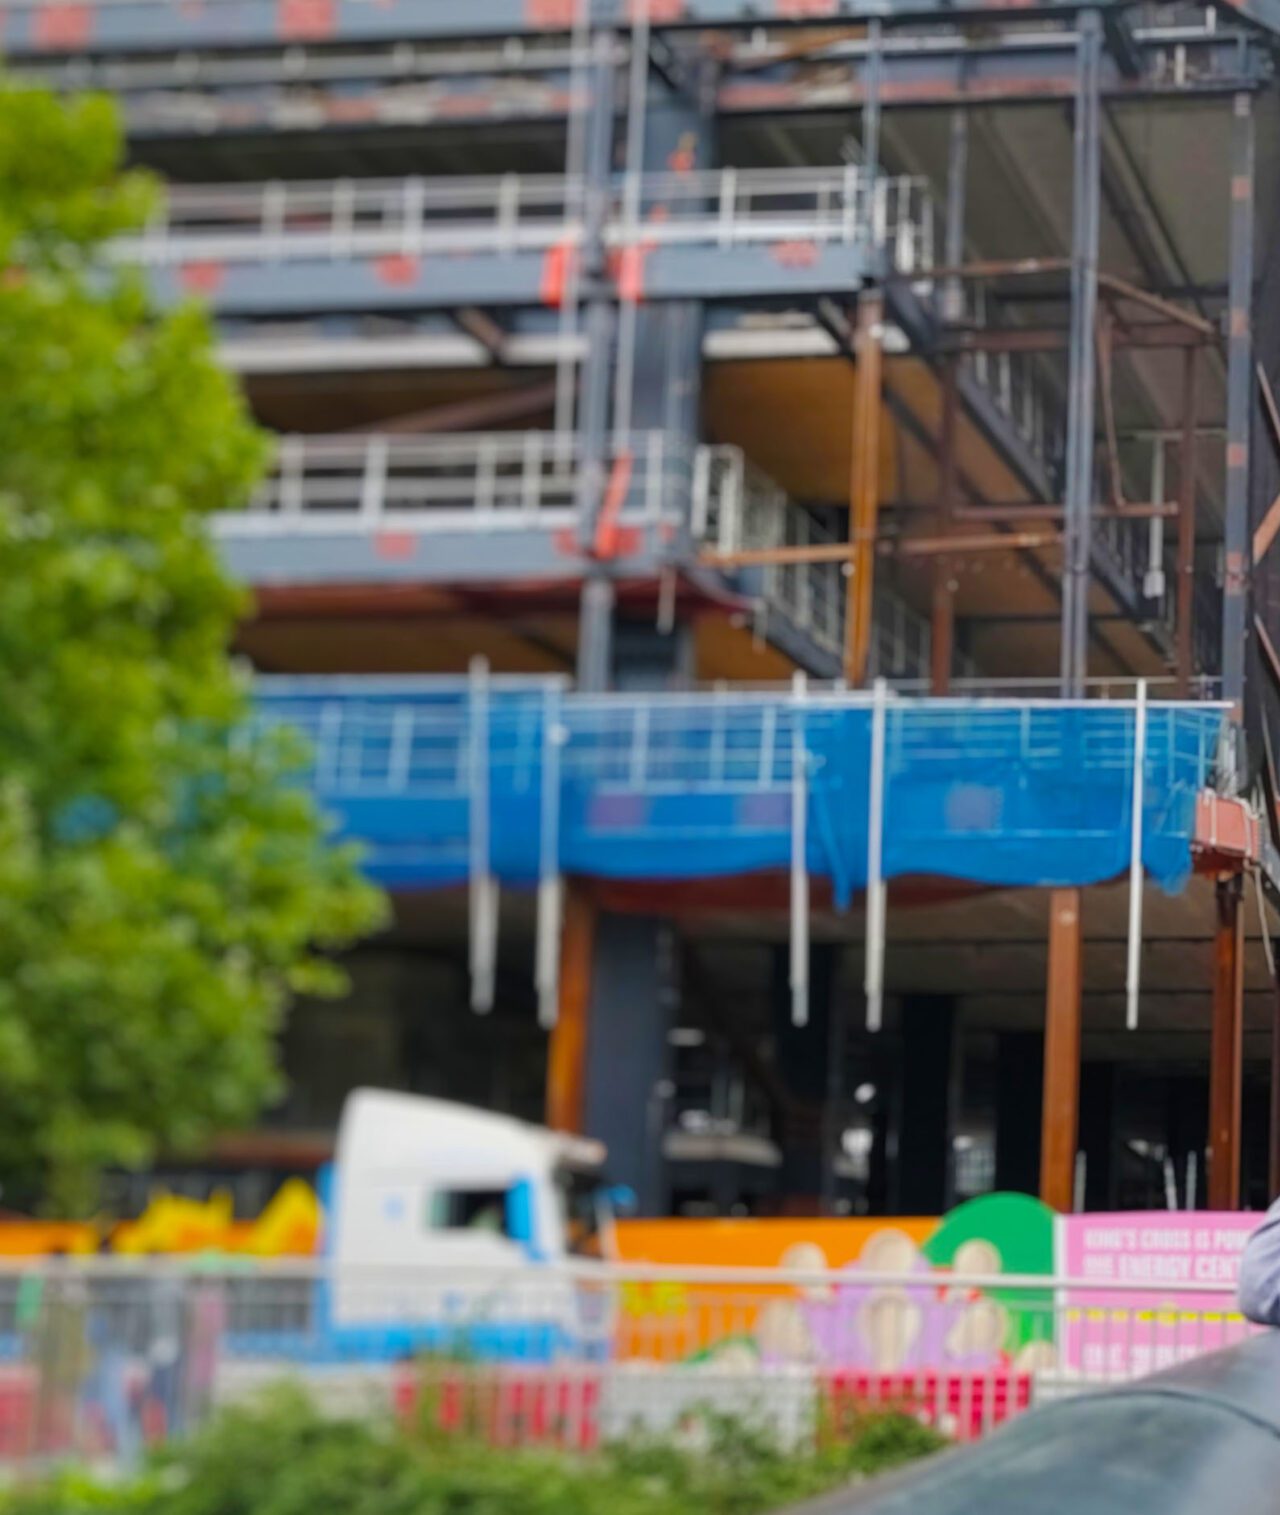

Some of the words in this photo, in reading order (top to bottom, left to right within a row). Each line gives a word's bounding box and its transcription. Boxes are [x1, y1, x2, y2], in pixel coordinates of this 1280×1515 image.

[1140, 1228, 1191, 1250] CROSS
[1213, 1229, 1250, 1250] POW
[1119, 1254, 1190, 1279] ENERGY
[1195, 1255, 1244, 1279] CENT
